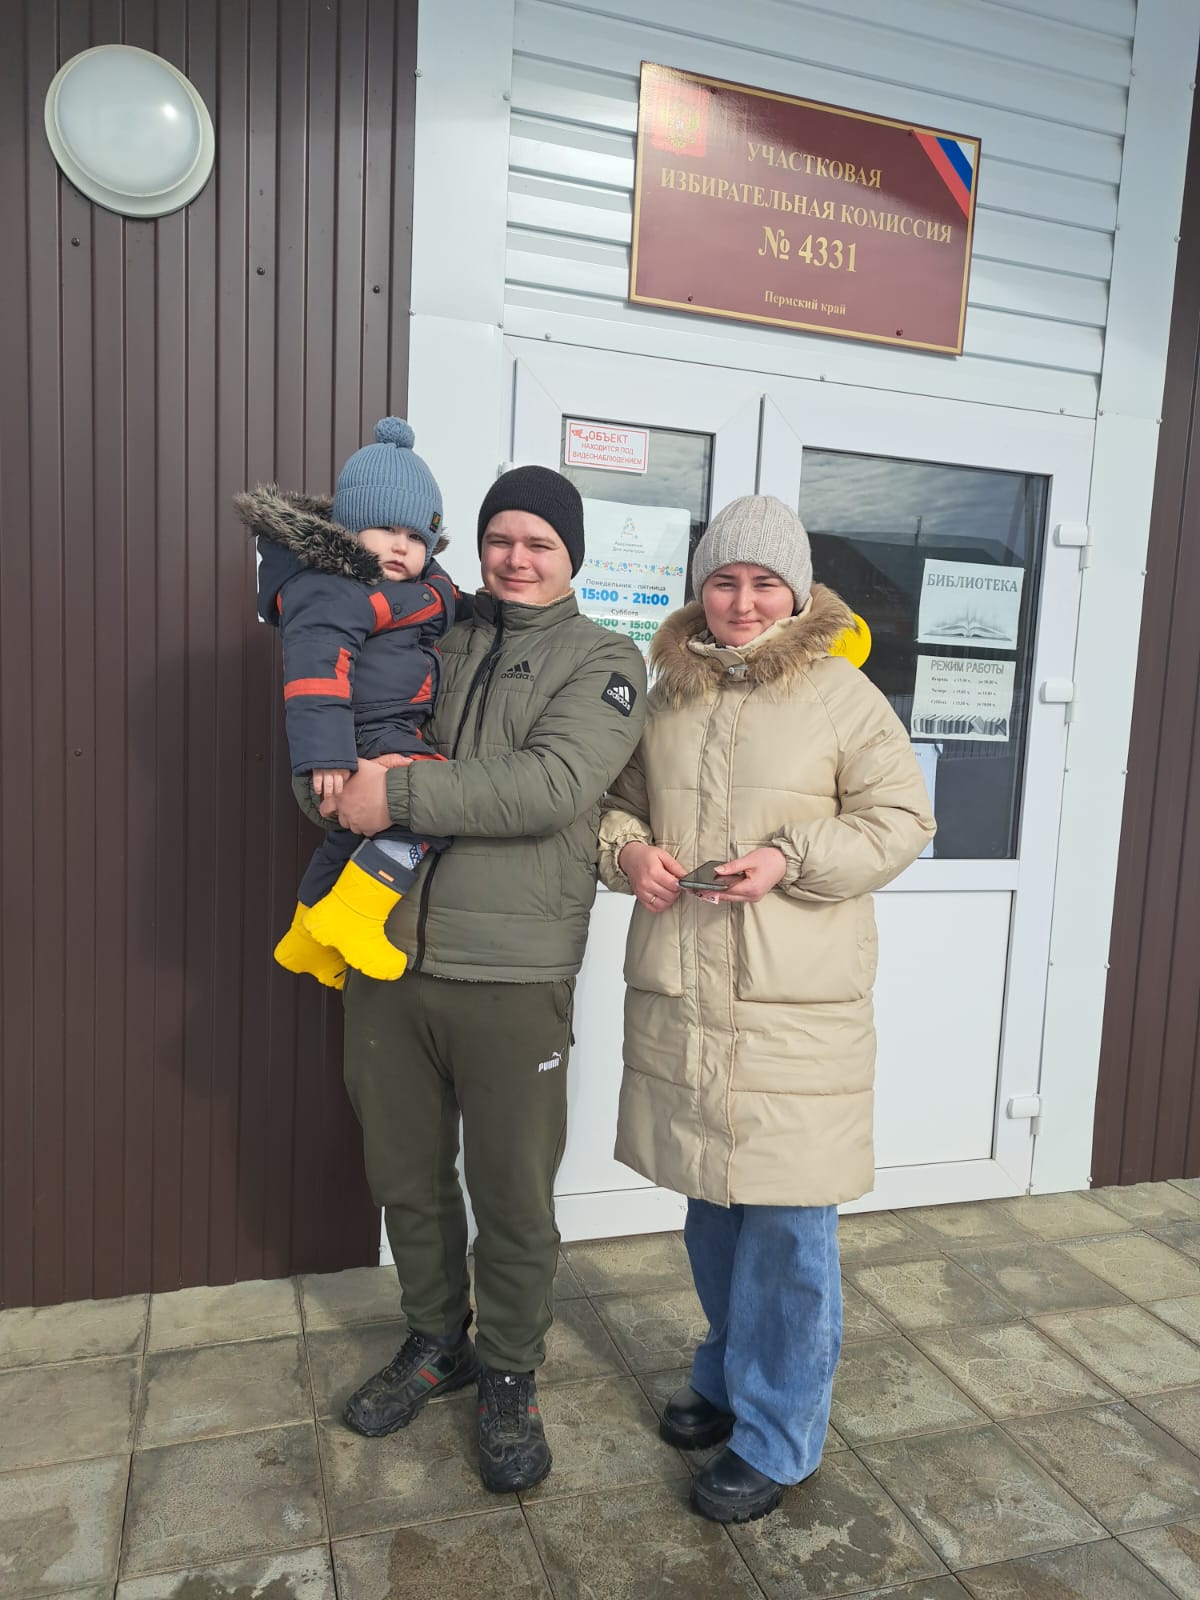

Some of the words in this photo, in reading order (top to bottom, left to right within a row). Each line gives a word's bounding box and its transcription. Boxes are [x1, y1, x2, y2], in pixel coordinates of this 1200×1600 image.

[747, 142, 883, 189] УЧАСТКОВАЯ
[660, 167, 835, 221] ИЗБИРАТЕЛЬНАЯ
[841, 205, 952, 244] КОМИССИЯ
[758, 226, 791, 261] №
[798, 233, 858, 272] 4331
[764, 290, 818, 312] Пермский
[821, 302, 847, 316] край
[588, 431, 628, 444] ОБЪЕКТ
[573, 451, 642, 464] ВИДЕОНАБЛЮДЕНИЕМ
[582, 443, 619, 453] НАХОДИТСЯ
[621, 447, 634, 455] ПОД
[586, 579, 632, 588] Понедельник
[637, 584, 667, 592] пятница
[927, 573, 1018, 593] БИБЛИОТЕКА
[581, 587, 619, 602] 15:00
[632, 592, 669, 606] 21:00
[611, 608, 639, 617] Суббота
[594, 618, 619, 628] 2:00
[630, 620, 659, 631] 15:00
[931, 660, 964, 673] РЕЖИМ
[966, 661, 1005, 675] РАБОТЫ
[606, 689, 631, 711] adidas
